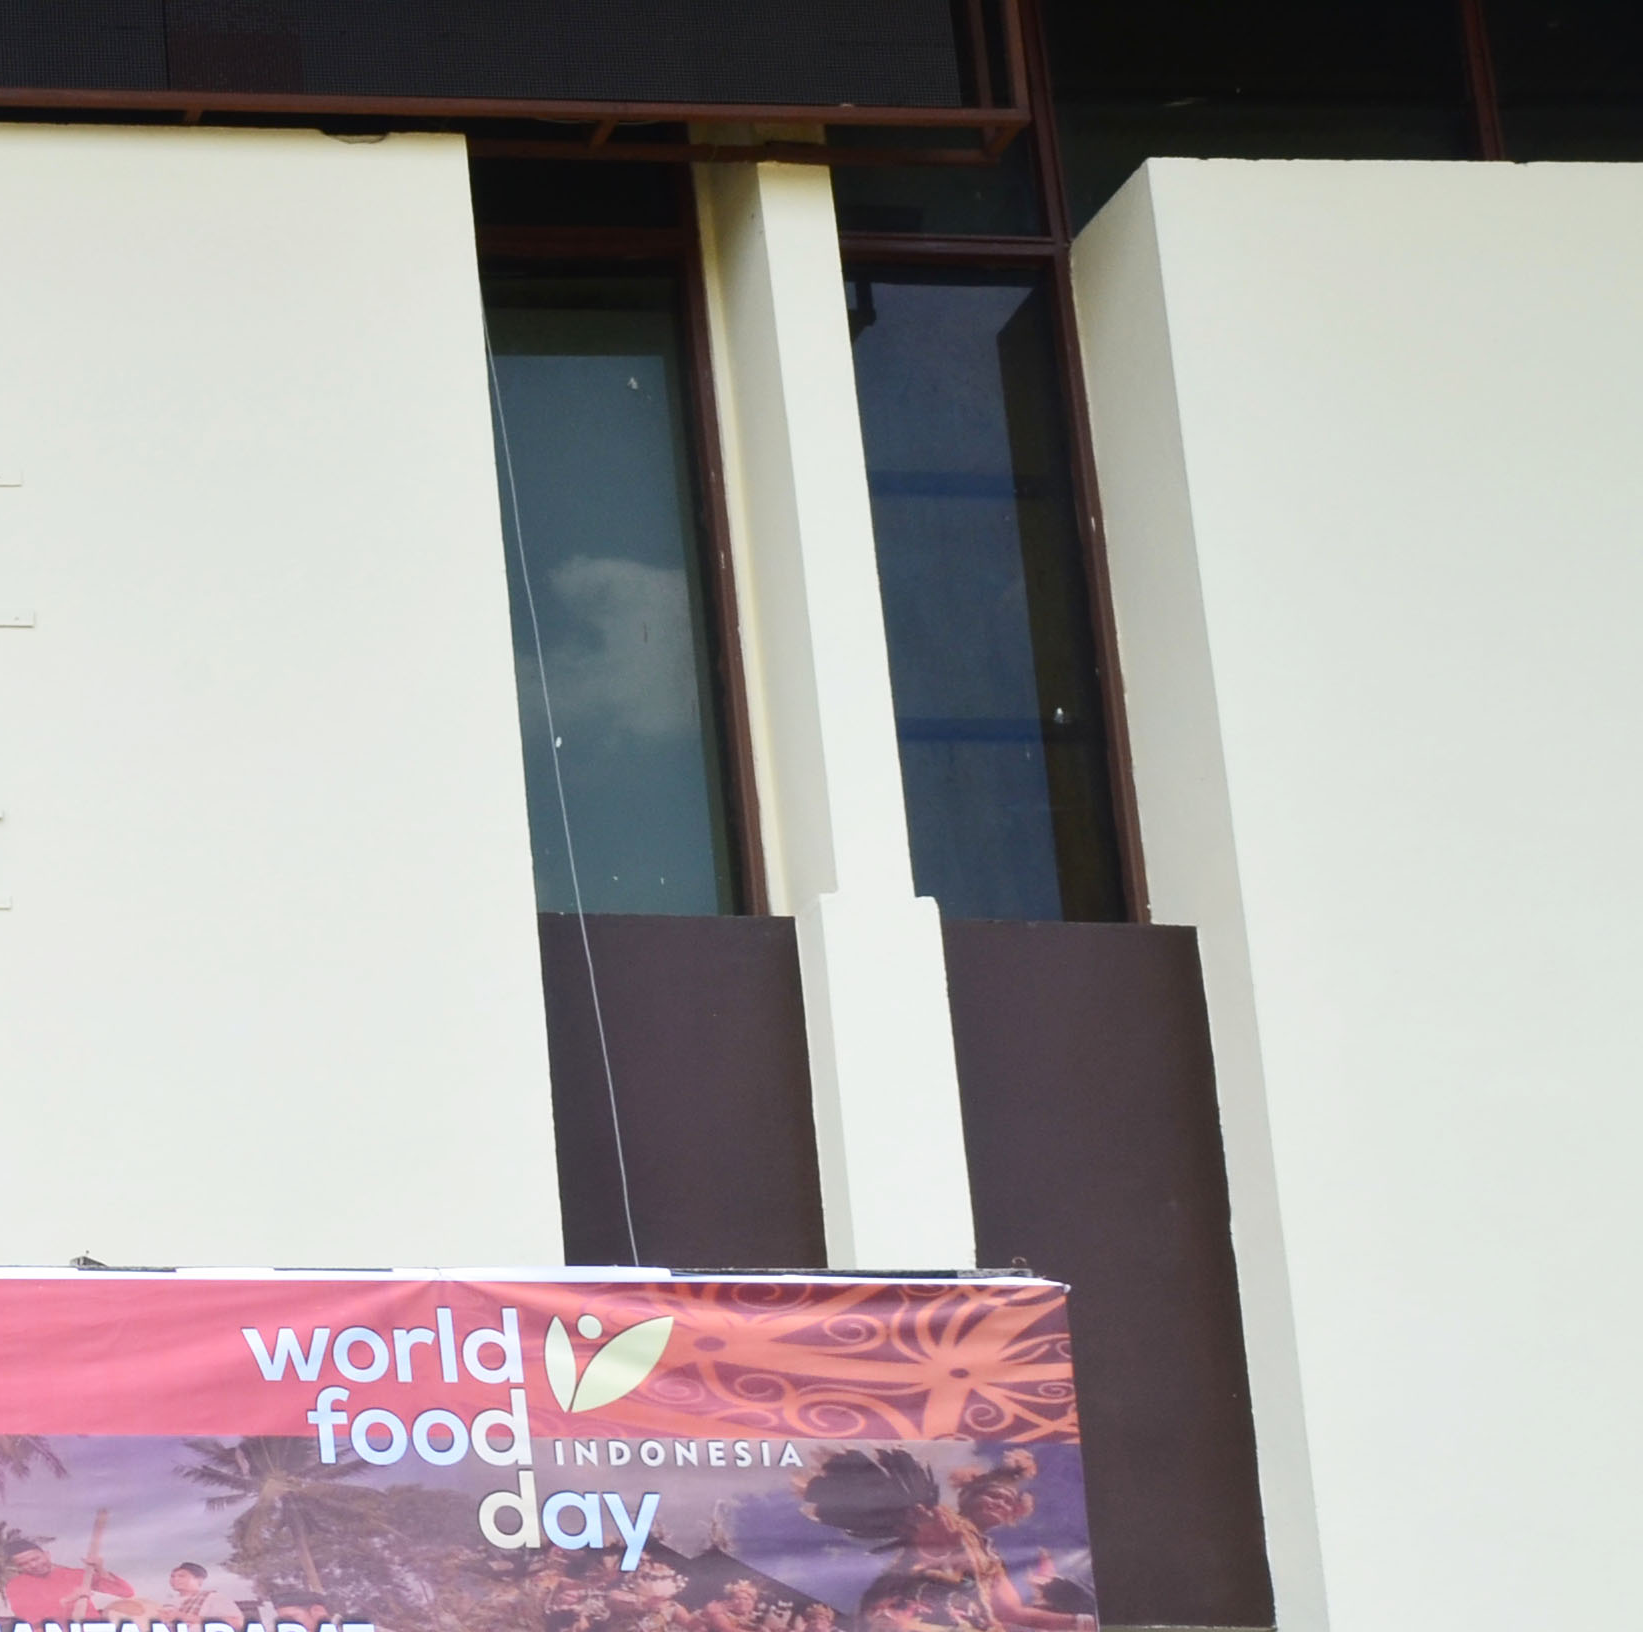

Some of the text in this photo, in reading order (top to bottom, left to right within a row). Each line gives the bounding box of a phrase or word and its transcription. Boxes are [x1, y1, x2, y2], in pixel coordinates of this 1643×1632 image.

[241, 1307, 525, 1385] world
[306, 1386, 533, 1467] food
[554, 1439, 805, 1468] INDONESIA
[477, 1470, 661, 1572] day
